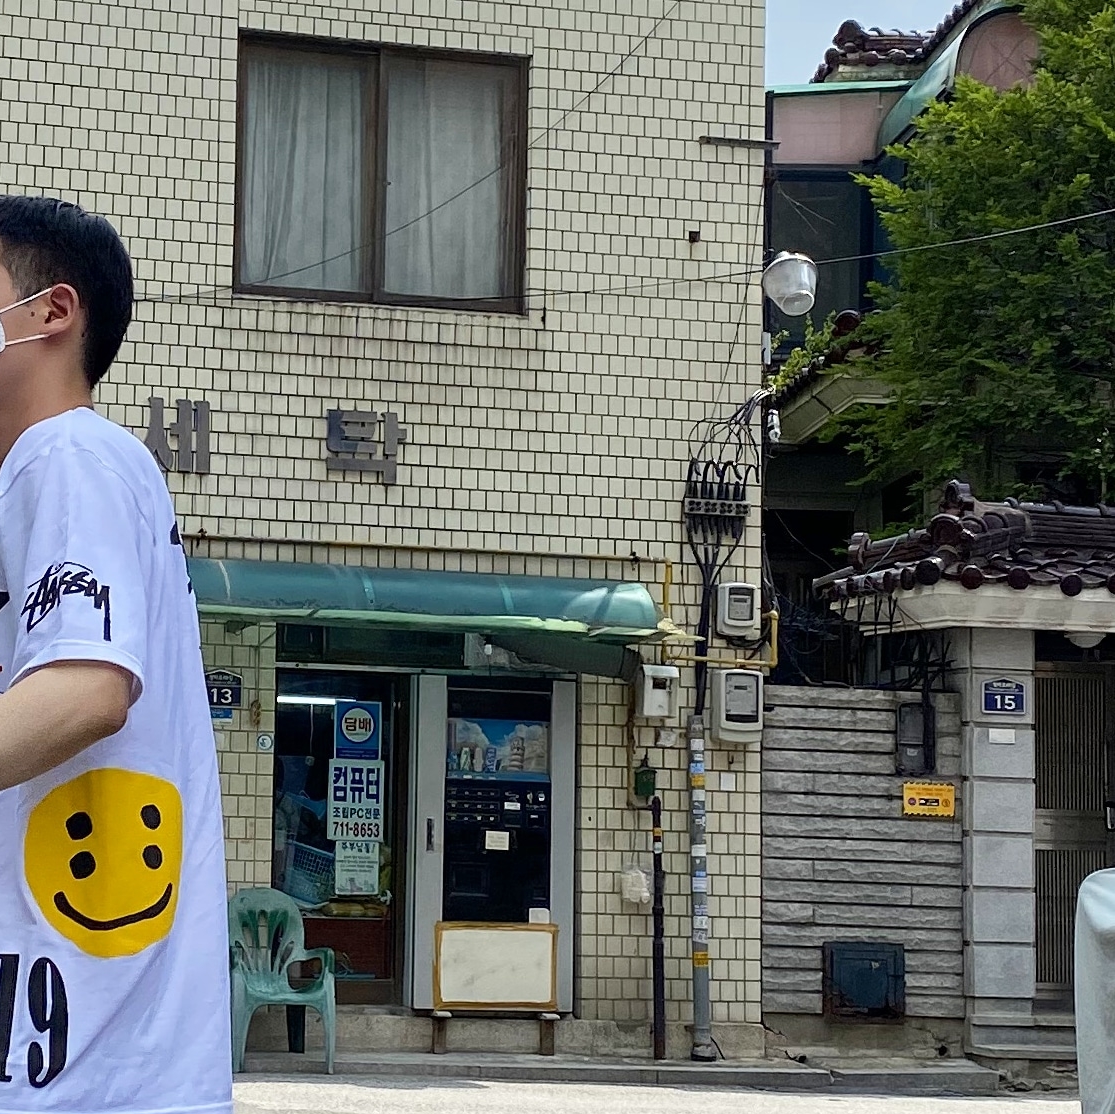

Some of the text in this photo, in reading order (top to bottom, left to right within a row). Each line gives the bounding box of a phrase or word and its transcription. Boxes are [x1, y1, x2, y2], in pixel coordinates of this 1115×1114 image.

[210, 687, 233, 704] 13
[994, 694, 1017, 711] 15
[344, 717, 372, 733] 담배
[332, 765, 381, 805] 컴퓨터
[332, 821, 380, 838] 711-8653
